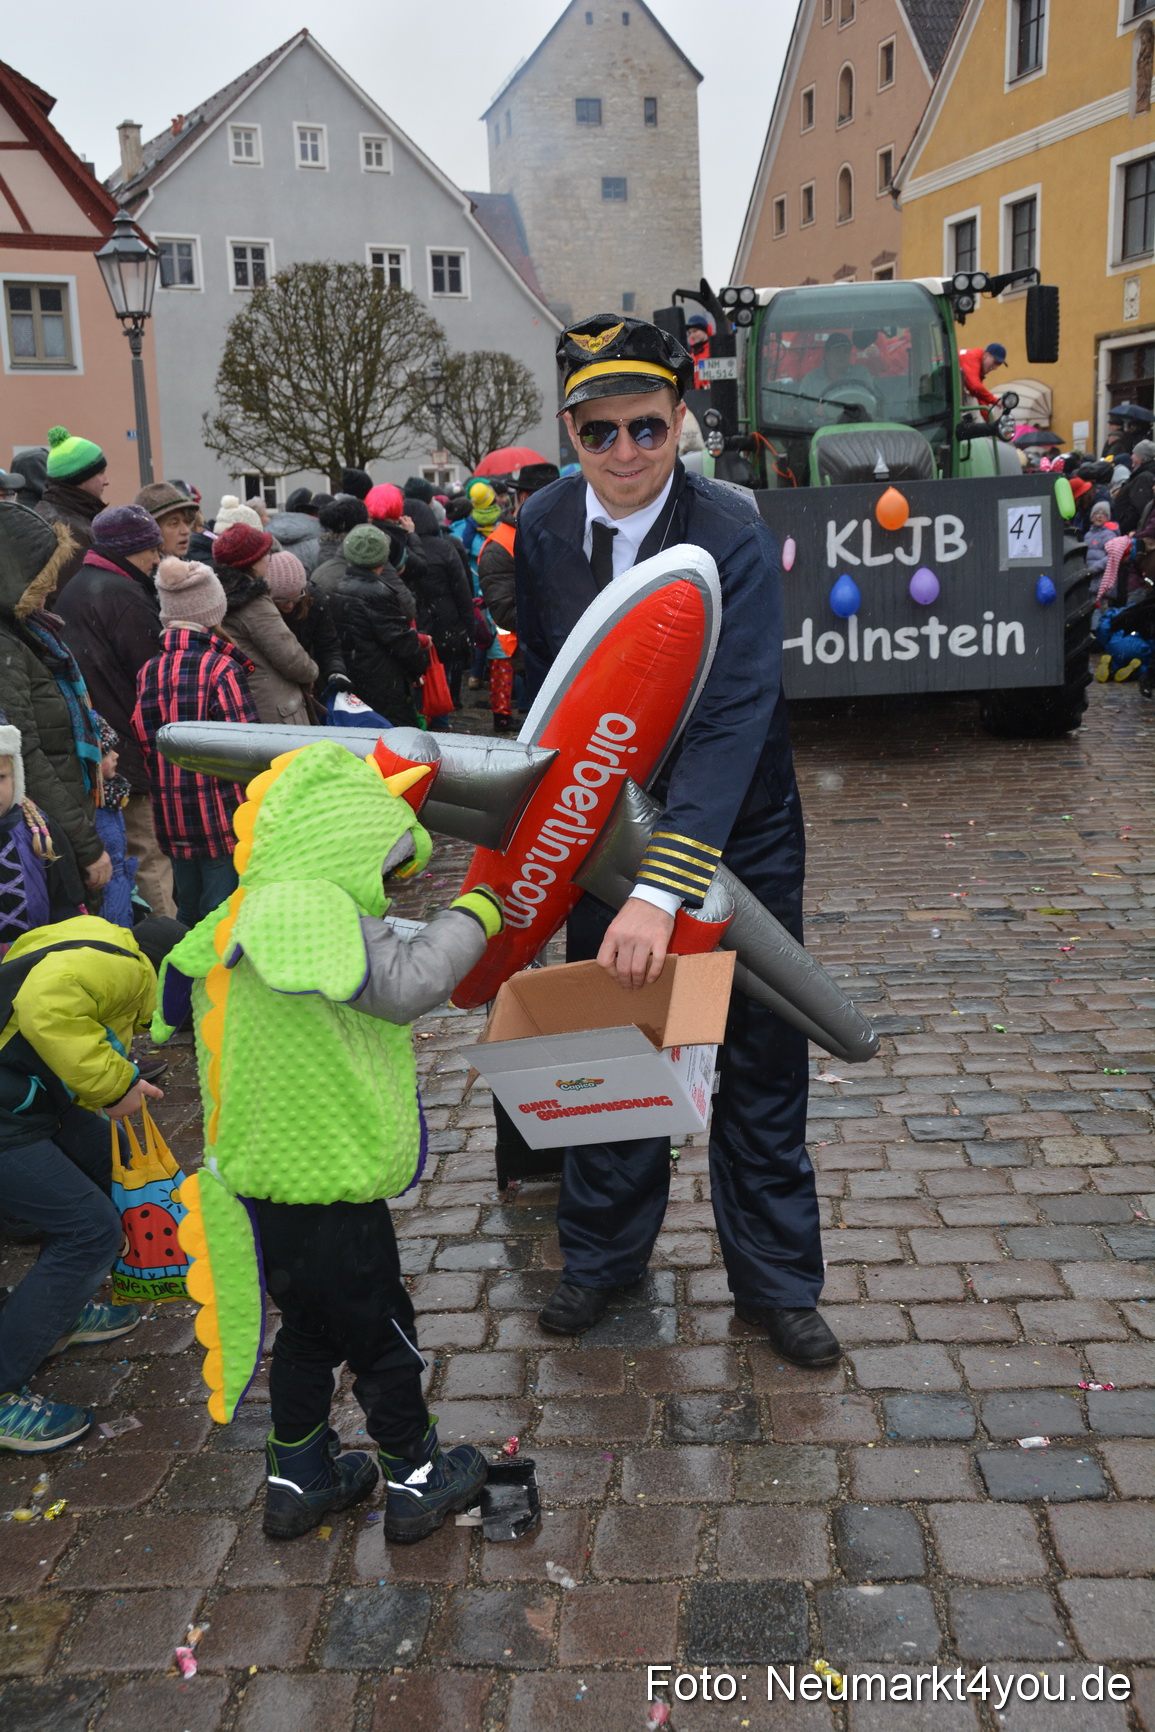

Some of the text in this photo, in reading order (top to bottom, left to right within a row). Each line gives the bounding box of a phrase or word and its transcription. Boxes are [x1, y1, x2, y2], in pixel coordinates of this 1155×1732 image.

[707, 360, 720, 369] NM
[1009, 513, 1042, 540] 47
[826, 514, 968, 568] KLJB
[502, 712, 638, 929] airberlin.com
[560, 1082, 597, 1091] Capico
[518, 1099, 562, 1114] BUNTE
[536, 1095, 673, 1121] BONBONMISCHUNG
